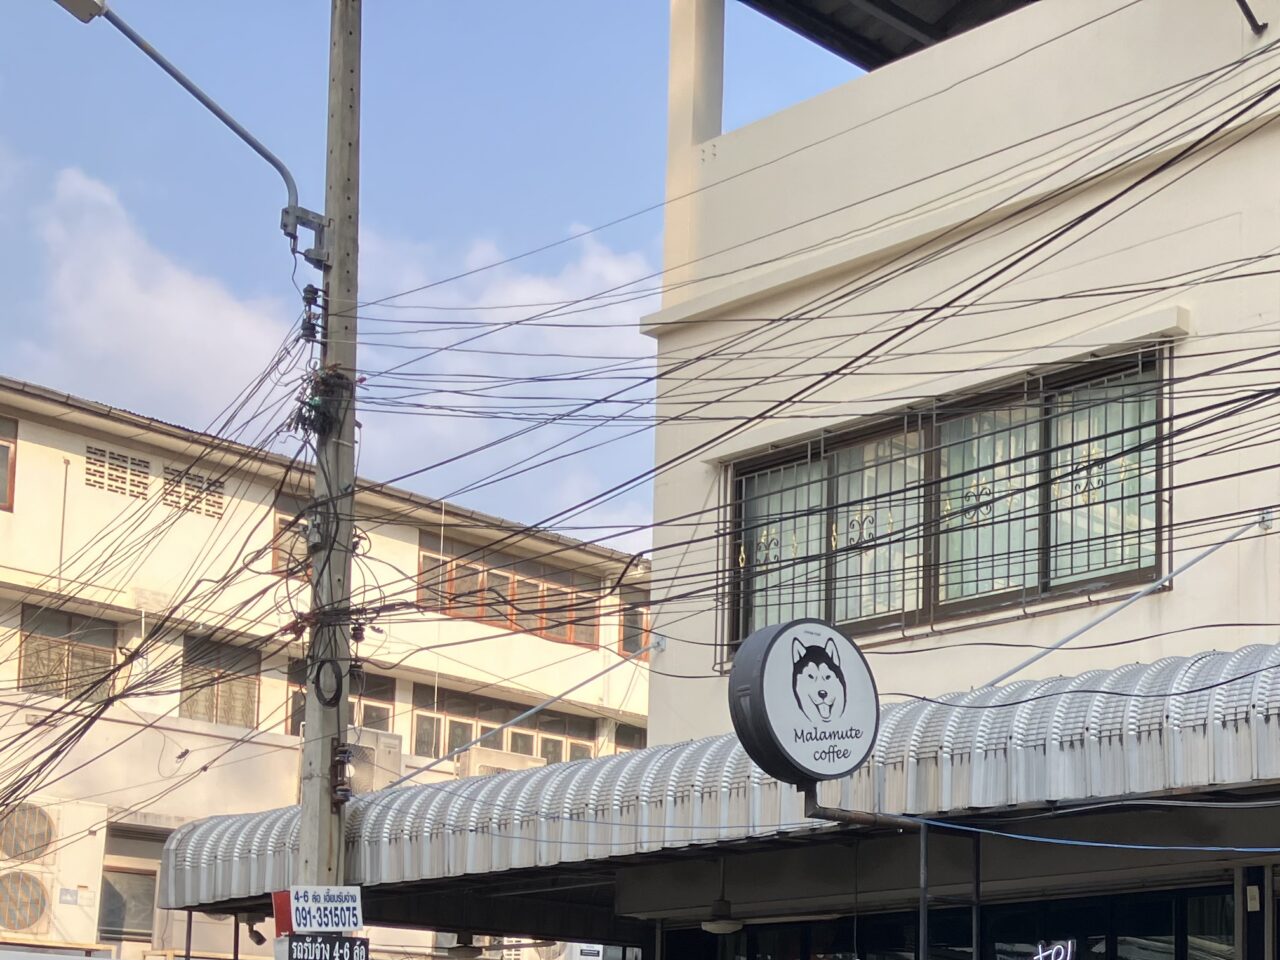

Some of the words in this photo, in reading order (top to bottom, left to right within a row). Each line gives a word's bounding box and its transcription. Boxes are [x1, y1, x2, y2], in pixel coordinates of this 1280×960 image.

[794, 727, 864, 743] Malamute
[814, 745, 851, 763] coffee
[294, 891, 309, 902] 4-6
[295, 906, 358, 928] 091-3515075
[292, 936, 330, 960] รถรับจ้าง
[333, 941, 350, 960] 4-6
